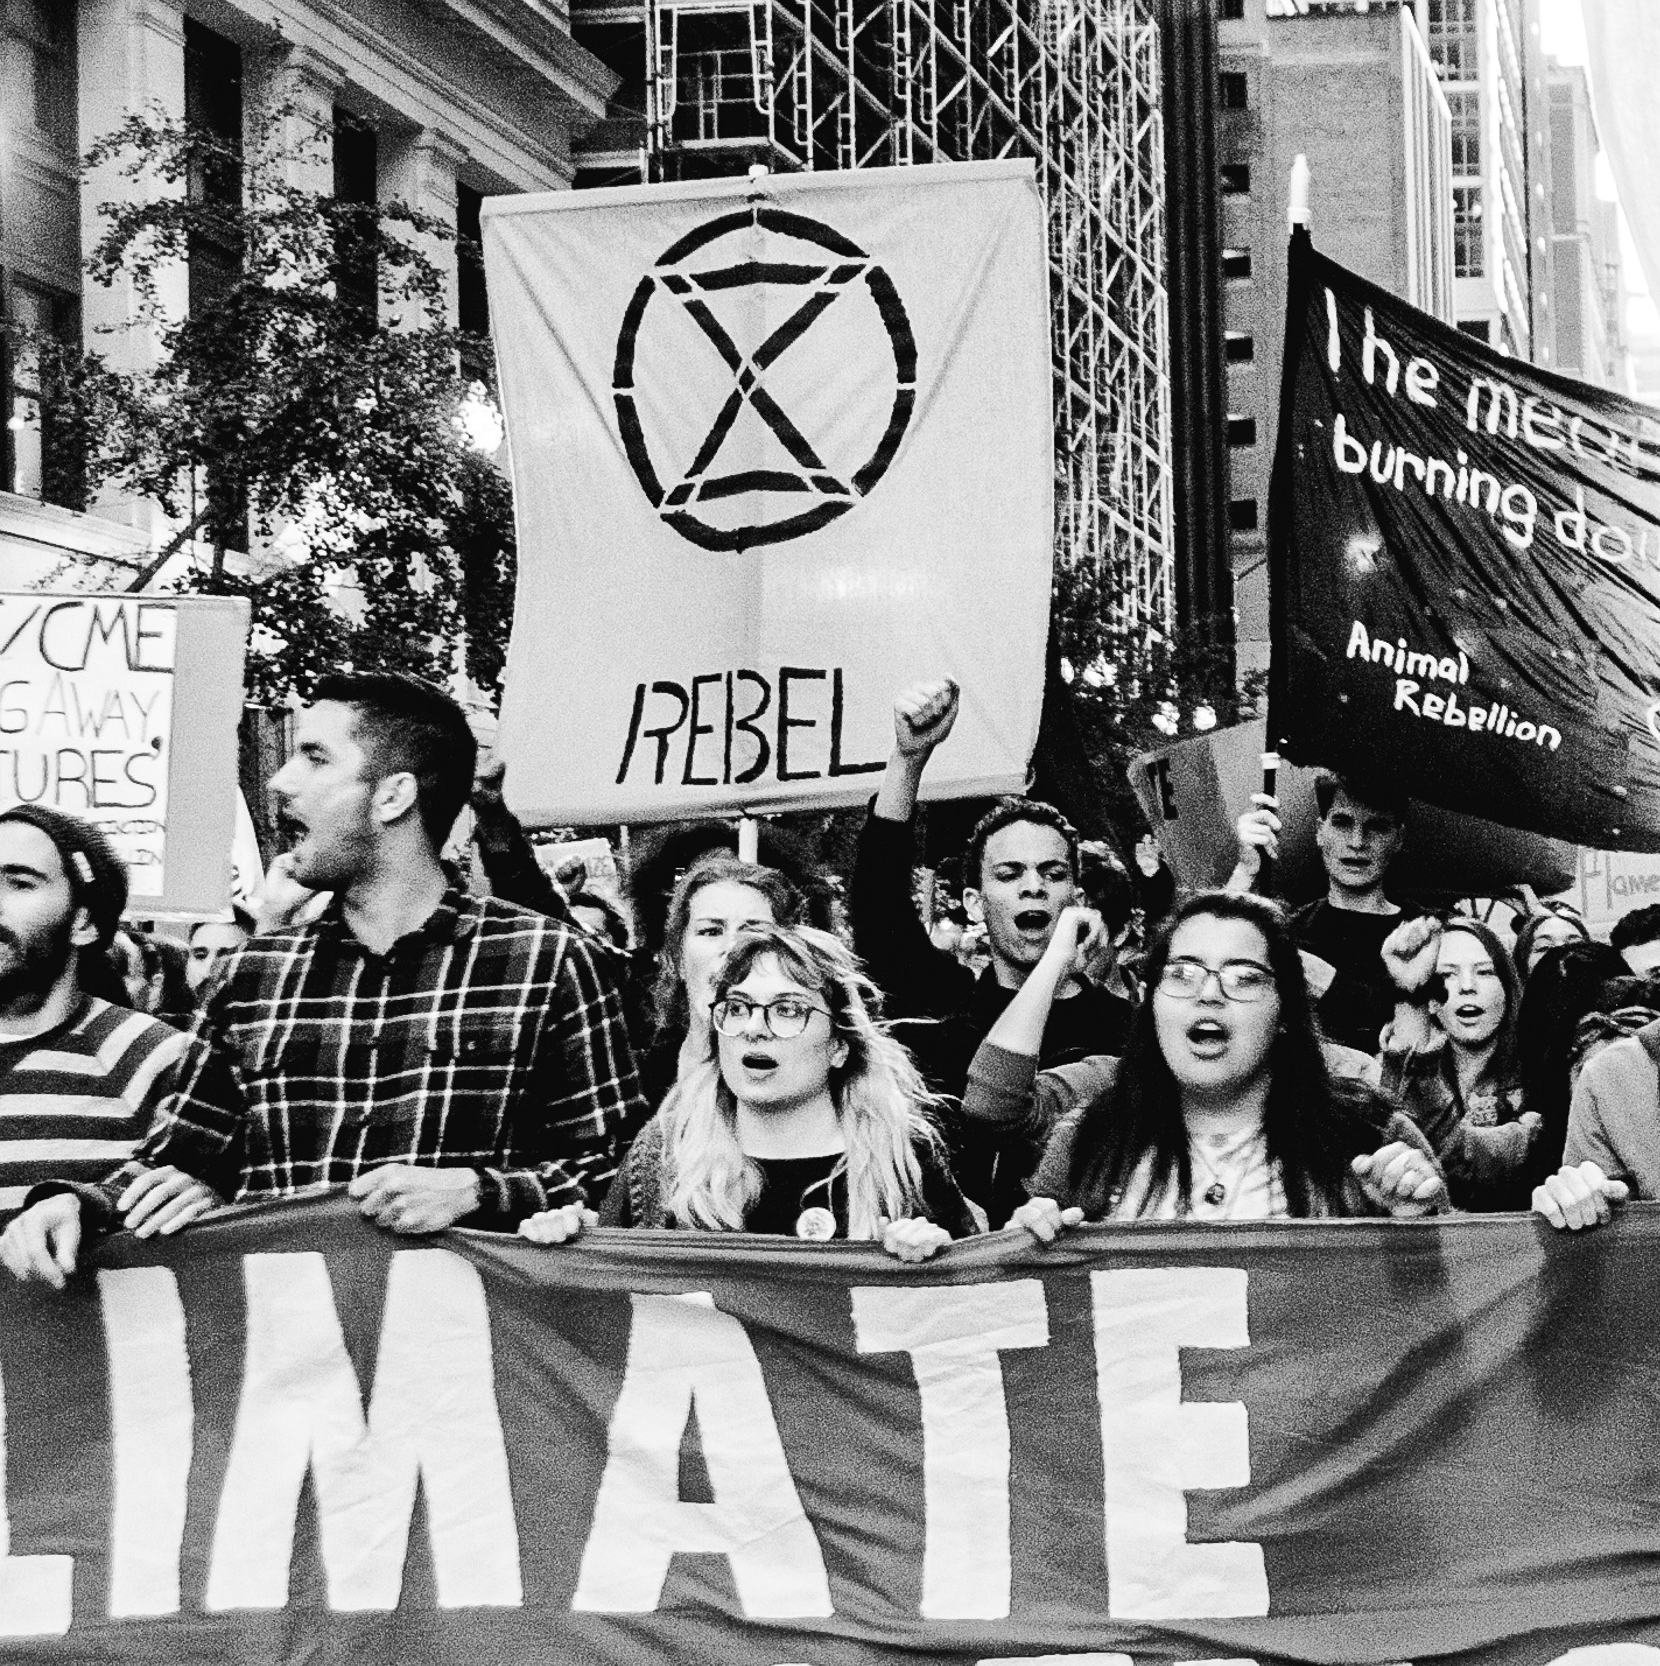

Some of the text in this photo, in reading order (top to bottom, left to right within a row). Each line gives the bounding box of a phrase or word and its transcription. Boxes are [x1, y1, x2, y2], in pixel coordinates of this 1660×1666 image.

[1333, 413, 1538, 549] burning
[0, 600, 177, 674] /CME
[1346, 620, 1469, 685] Animal
[615, 666, 887, 785] REBEL
[1393, 678, 1562, 752] Rebellion
